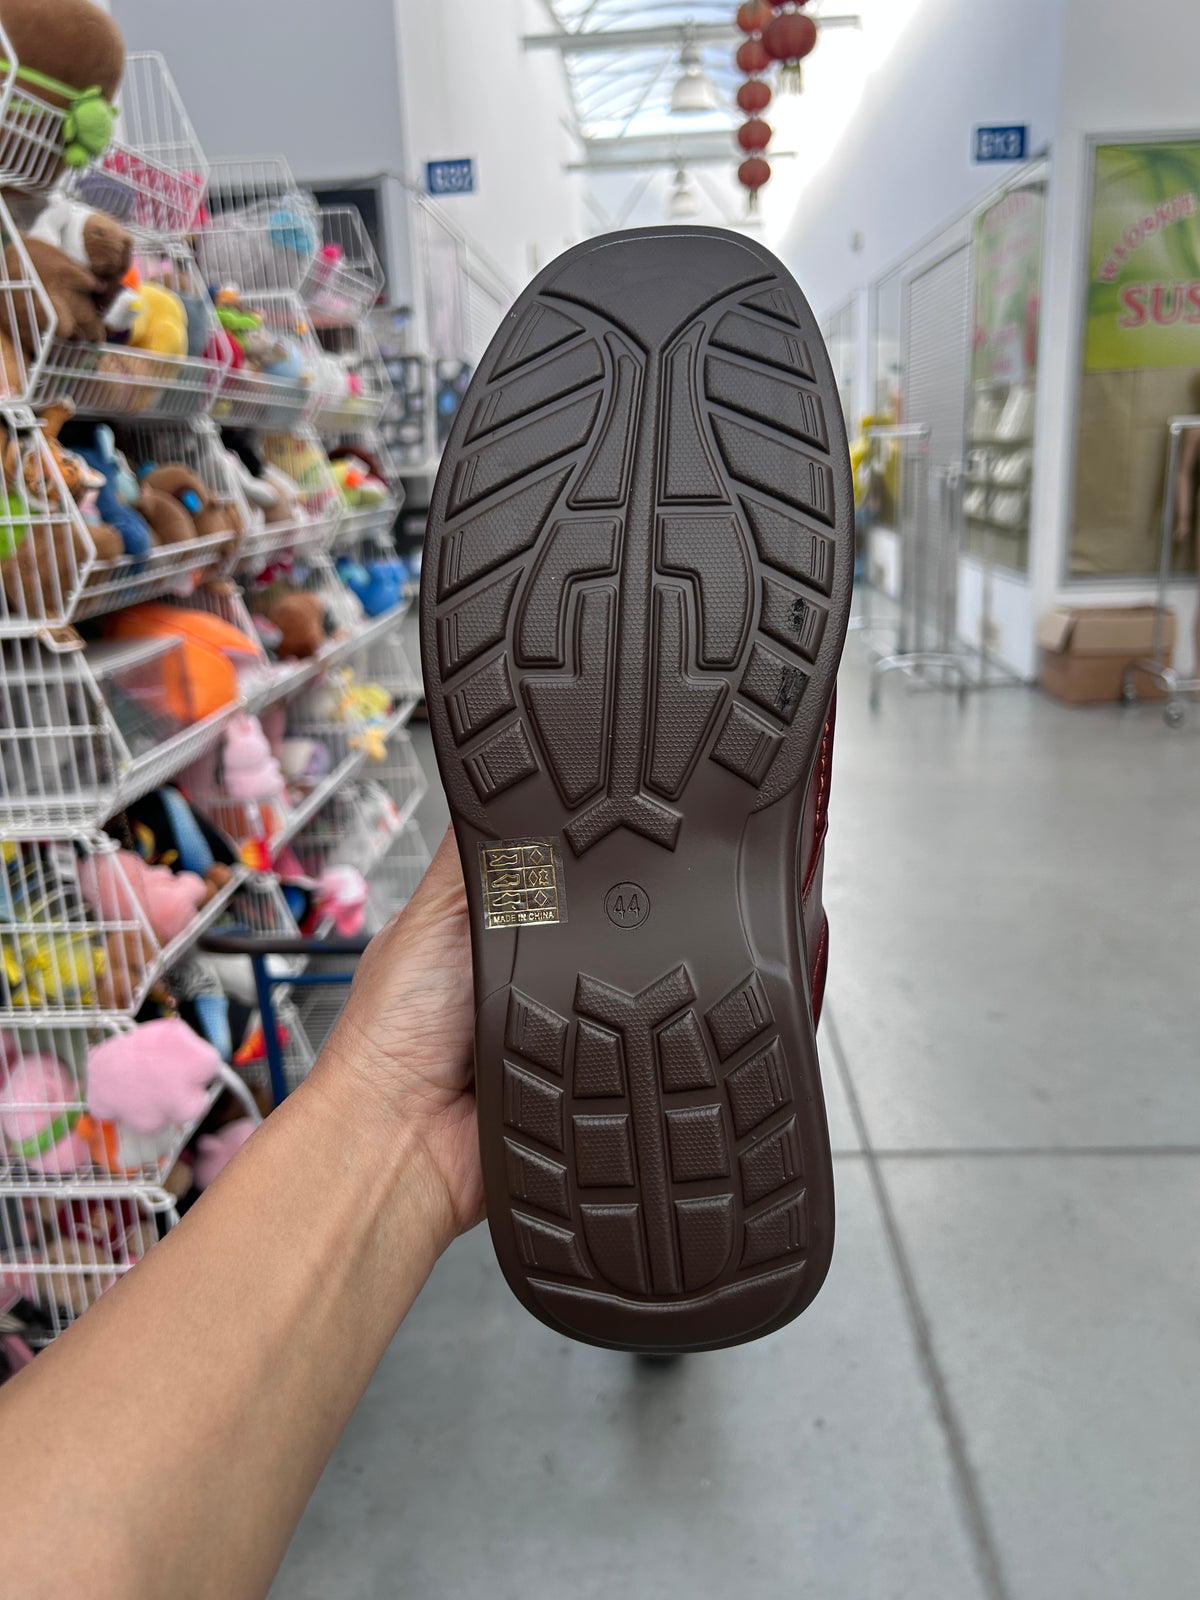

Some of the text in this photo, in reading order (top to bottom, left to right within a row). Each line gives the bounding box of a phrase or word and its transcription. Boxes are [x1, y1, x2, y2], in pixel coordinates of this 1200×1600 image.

[613, 893, 640, 919] 44
[493, 911, 555, 923] MADE IN CHINA
